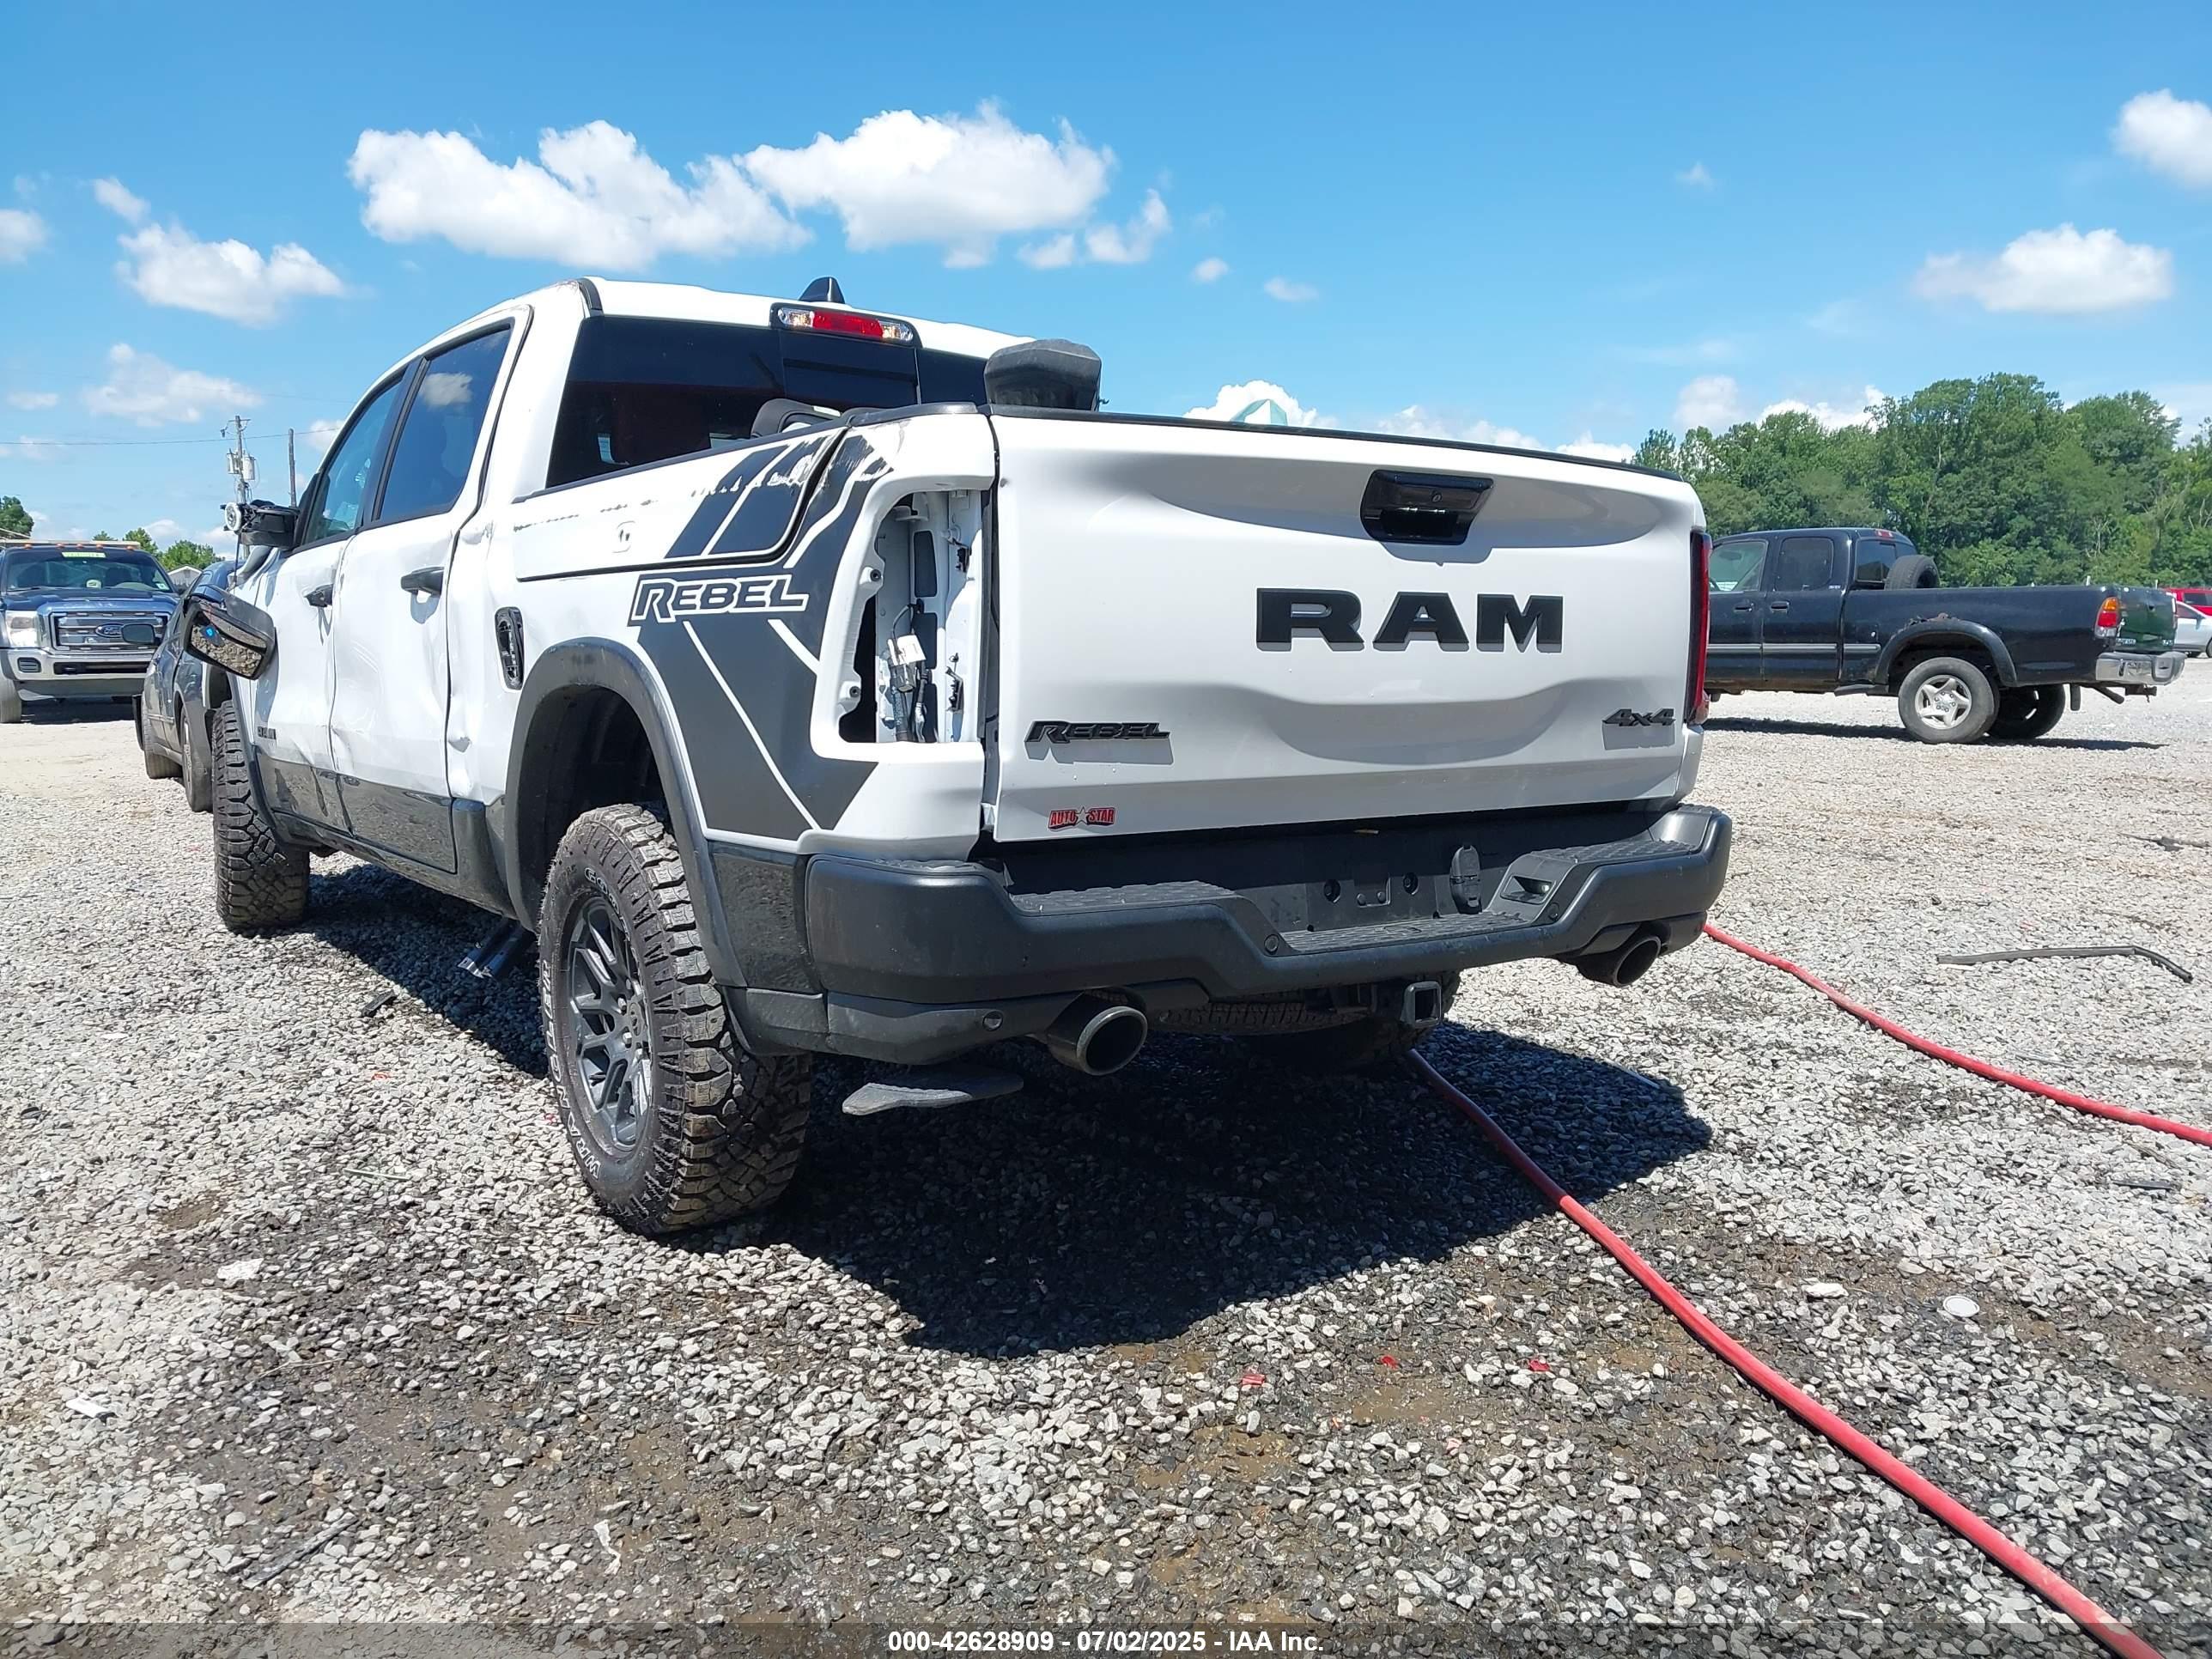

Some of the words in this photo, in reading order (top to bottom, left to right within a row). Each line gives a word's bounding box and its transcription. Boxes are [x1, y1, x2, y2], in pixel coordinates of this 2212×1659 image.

[632, 575, 808, 622] REBEL
[1256, 588, 1563, 643] RAM
[1024, 721, 1170, 744] REBEL
[1602, 708, 1675, 726] 4x4
[1049, 811, 1077, 825] AUTO
[1089, 809, 1115, 822] STAR
[541, 958, 602, 1180] WRANGLER
